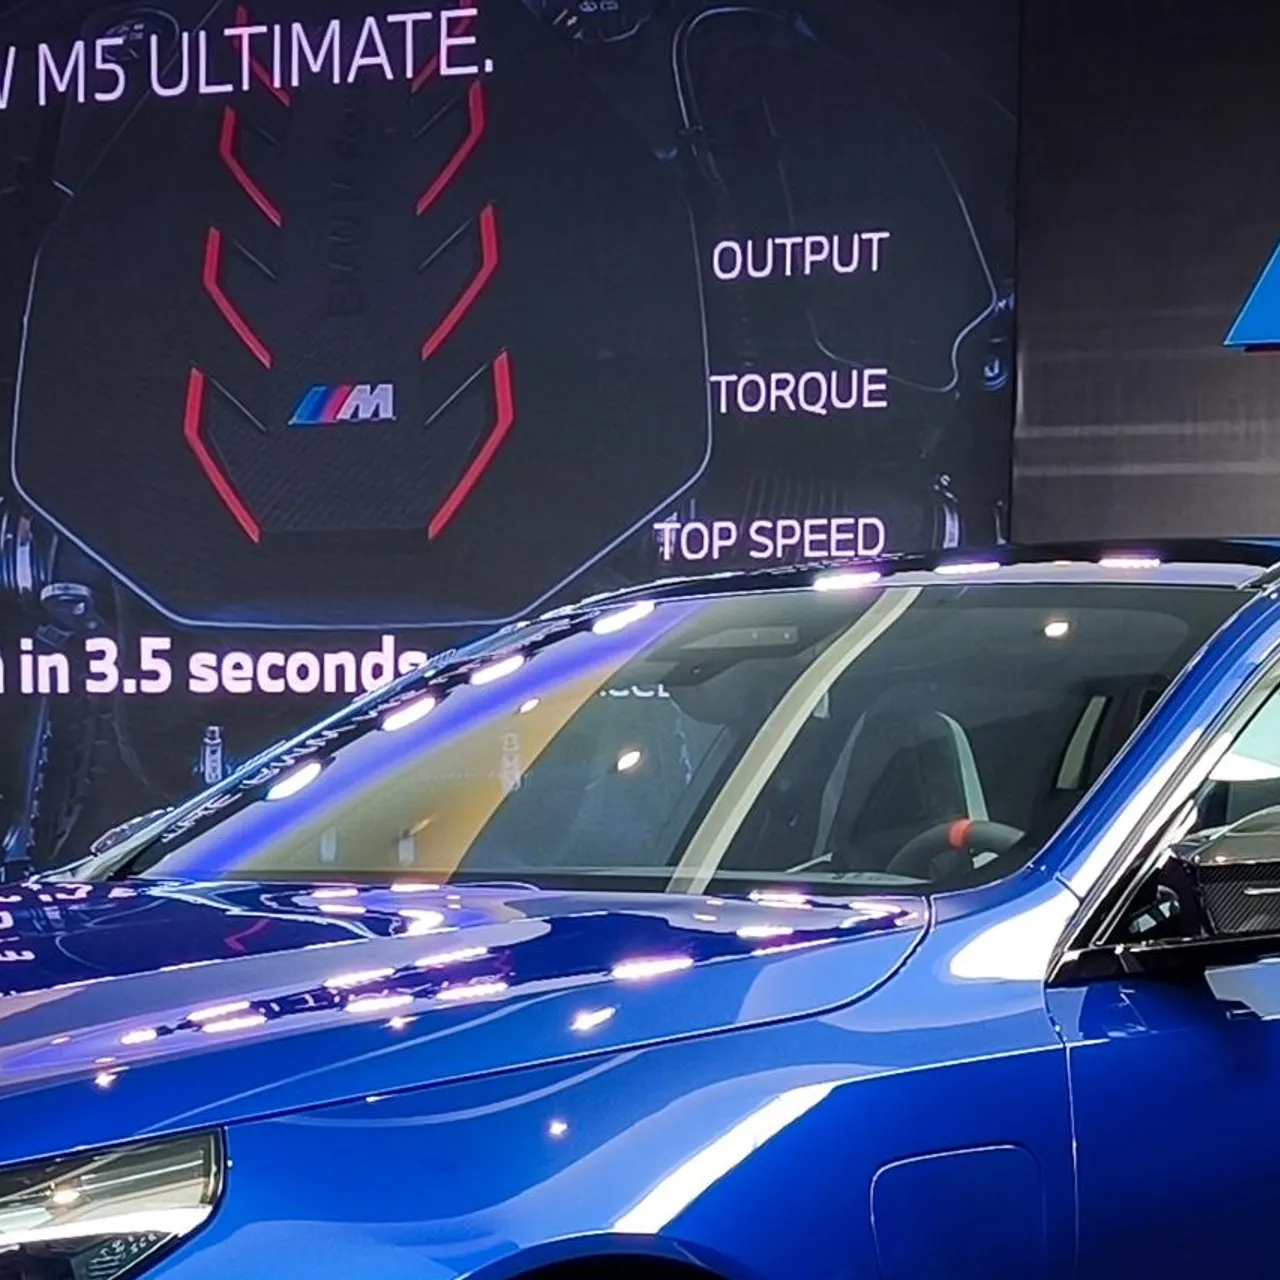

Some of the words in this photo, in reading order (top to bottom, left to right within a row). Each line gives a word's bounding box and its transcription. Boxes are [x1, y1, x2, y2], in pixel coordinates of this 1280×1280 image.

[37, 37, 125, 106] M5
[149, 8, 494, 97] ULTIMATE.
[712, 231, 890, 280] OUTPUT
[709, 368, 888, 416] TORQUE
[653, 521, 737, 560] TOP
[749, 517, 885, 558] SPEED
[20, 637, 70, 694] in
[85, 636, 172, 694] 3.5
